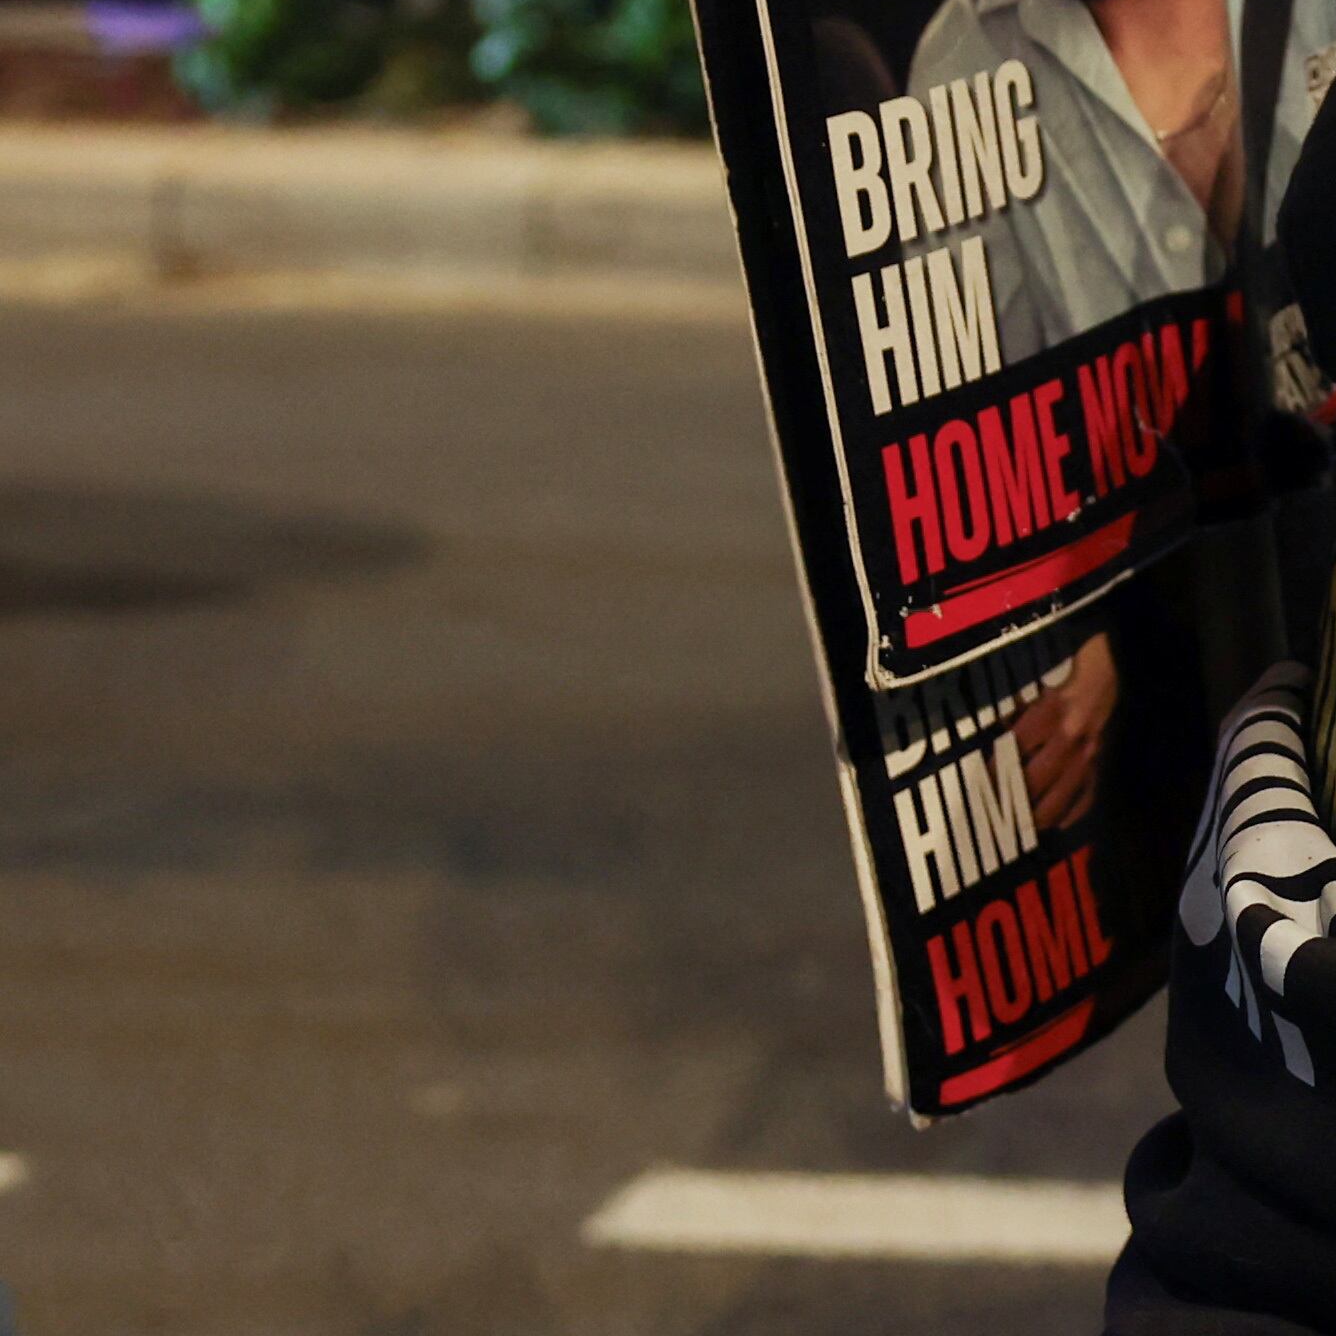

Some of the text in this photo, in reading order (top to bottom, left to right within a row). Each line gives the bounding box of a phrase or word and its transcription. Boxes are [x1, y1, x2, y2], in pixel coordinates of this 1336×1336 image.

[826, 58, 1046, 258] BRING
[851, 235, 1001, 417] HIM
[881, 377, 1081, 586] HOME
[1077, 289, 1244, 501] NOW
[893, 730, 1038, 915] HIM
